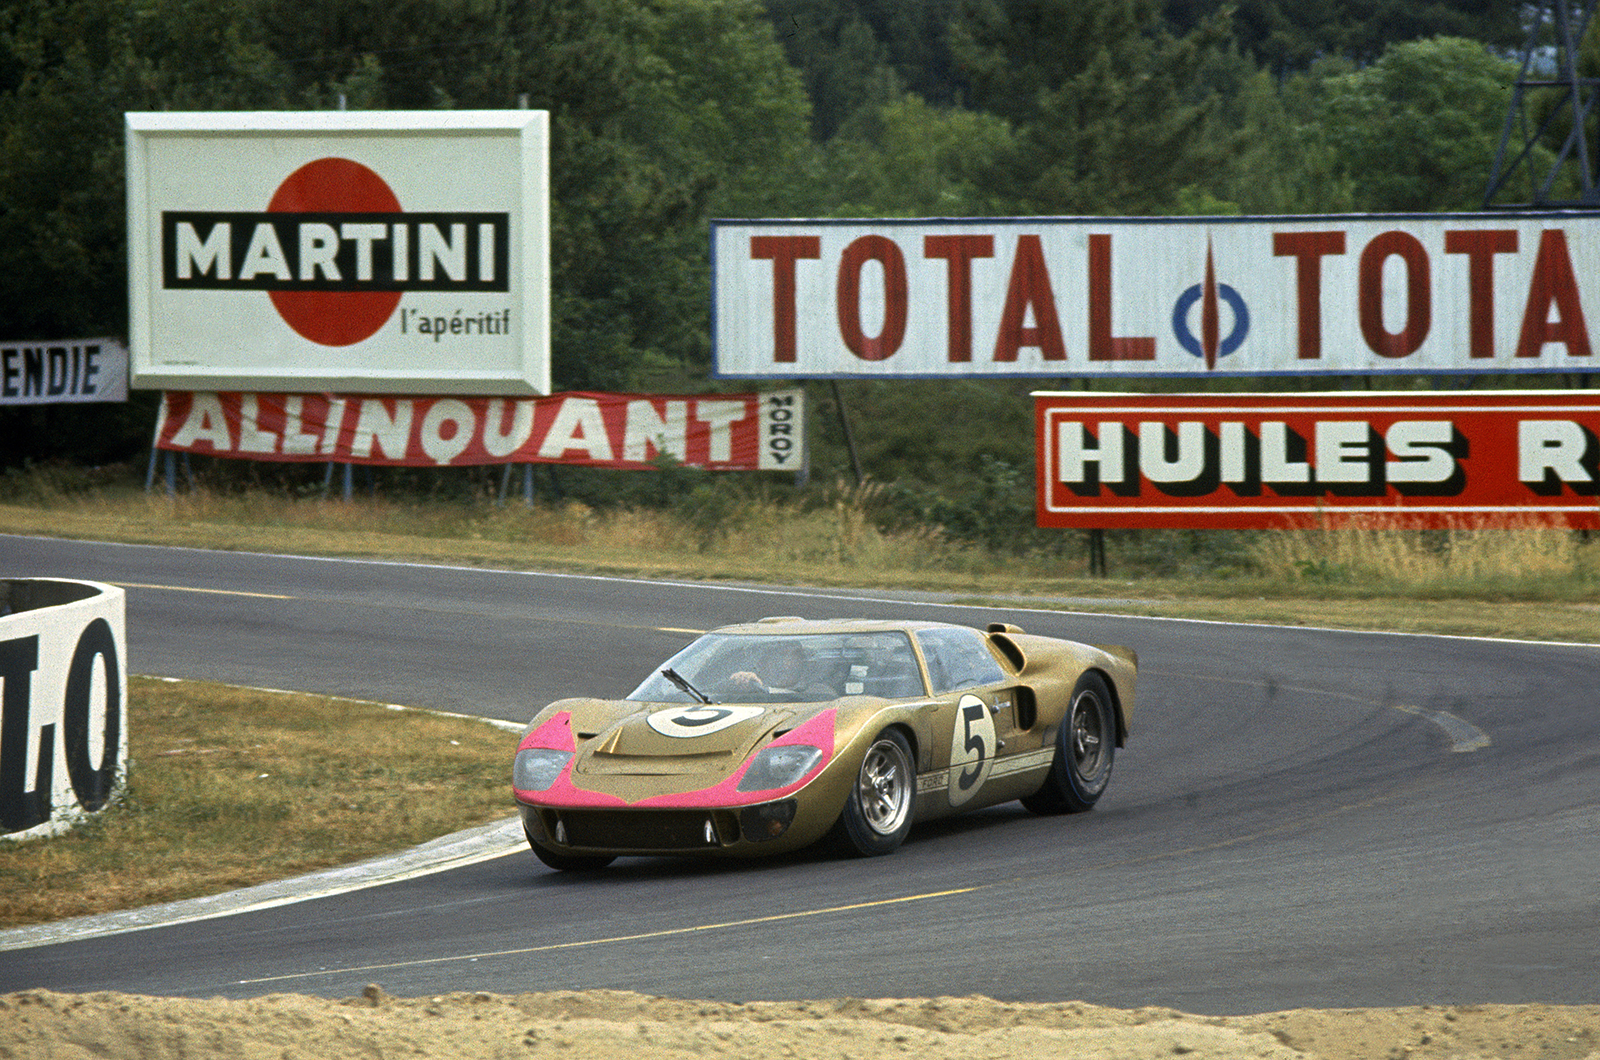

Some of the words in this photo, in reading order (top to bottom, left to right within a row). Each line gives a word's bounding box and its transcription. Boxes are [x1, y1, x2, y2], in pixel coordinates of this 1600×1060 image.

[174, 221, 496, 282] MARTINI
[401, 308, 510, 343] l'apéritif
[750, 233, 1157, 363] TOTAL
[1271, 228, 1593, 360] TOTA
[1, 344, 101, 397] ENDIE
[169, 391, 747, 465] ALLINQUANT
[1058, 421, 1458, 485] HUILES
[1518, 420, 1595, 483] R
[957, 704, 986, 791] 5
